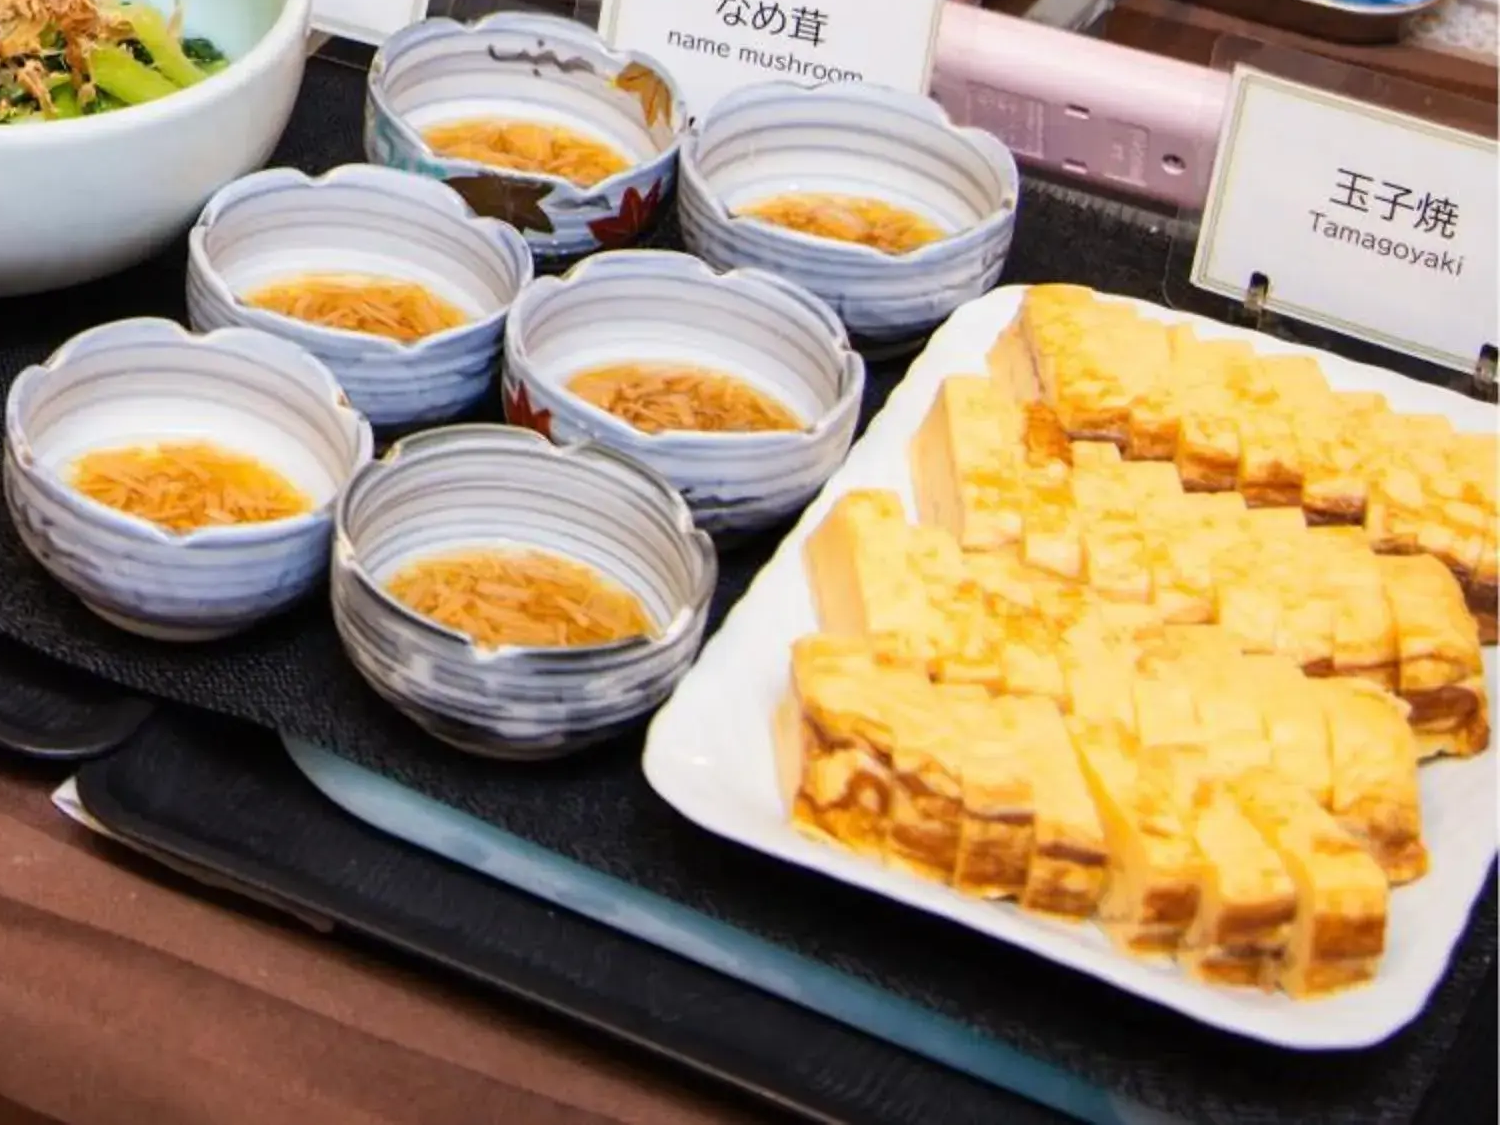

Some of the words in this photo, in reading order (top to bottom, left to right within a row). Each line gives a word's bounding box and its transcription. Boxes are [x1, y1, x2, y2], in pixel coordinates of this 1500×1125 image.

[667, 29, 731, 58] name
[1329, 167, 1460, 241] 玉子焼
[1308, 209, 1466, 277] Tamagoyaki
